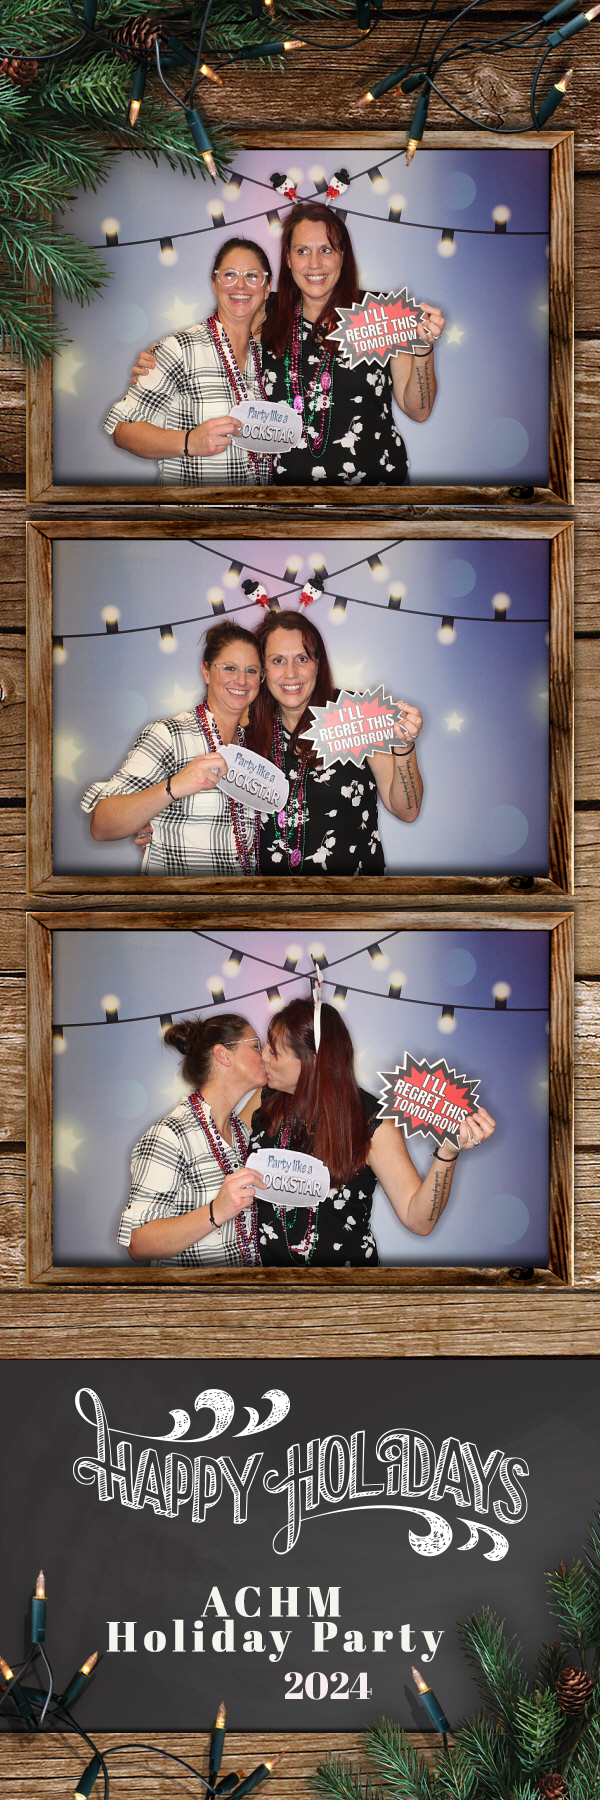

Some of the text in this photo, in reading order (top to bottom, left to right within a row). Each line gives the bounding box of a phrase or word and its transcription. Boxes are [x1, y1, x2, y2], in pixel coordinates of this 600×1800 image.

[363, 307, 389, 324] I'LL
[345, 315, 418, 342] REGRET THIS
[353, 329, 417, 353] TOMORROW
[247, 406, 289, 423] Party like a
[242, 423, 295, 444] OCKSTAR
[338, 705, 365, 723] I'LL
[319, 713, 395, 742] REGRET THIS
[327, 728, 394, 753] TOMORROW
[234, 752, 276, 783] Party like a
[222, 767, 280, 807] OCKSTAR
[422, 1073, 448, 1098] I'LL
[393, 1078, 469, 1122] REGRET THIS
[393, 1096, 460, 1135] TOMORROW
[267, 1154, 313, 1175] Party like a
[263, 1172, 322, 1197] OCKSTAR
